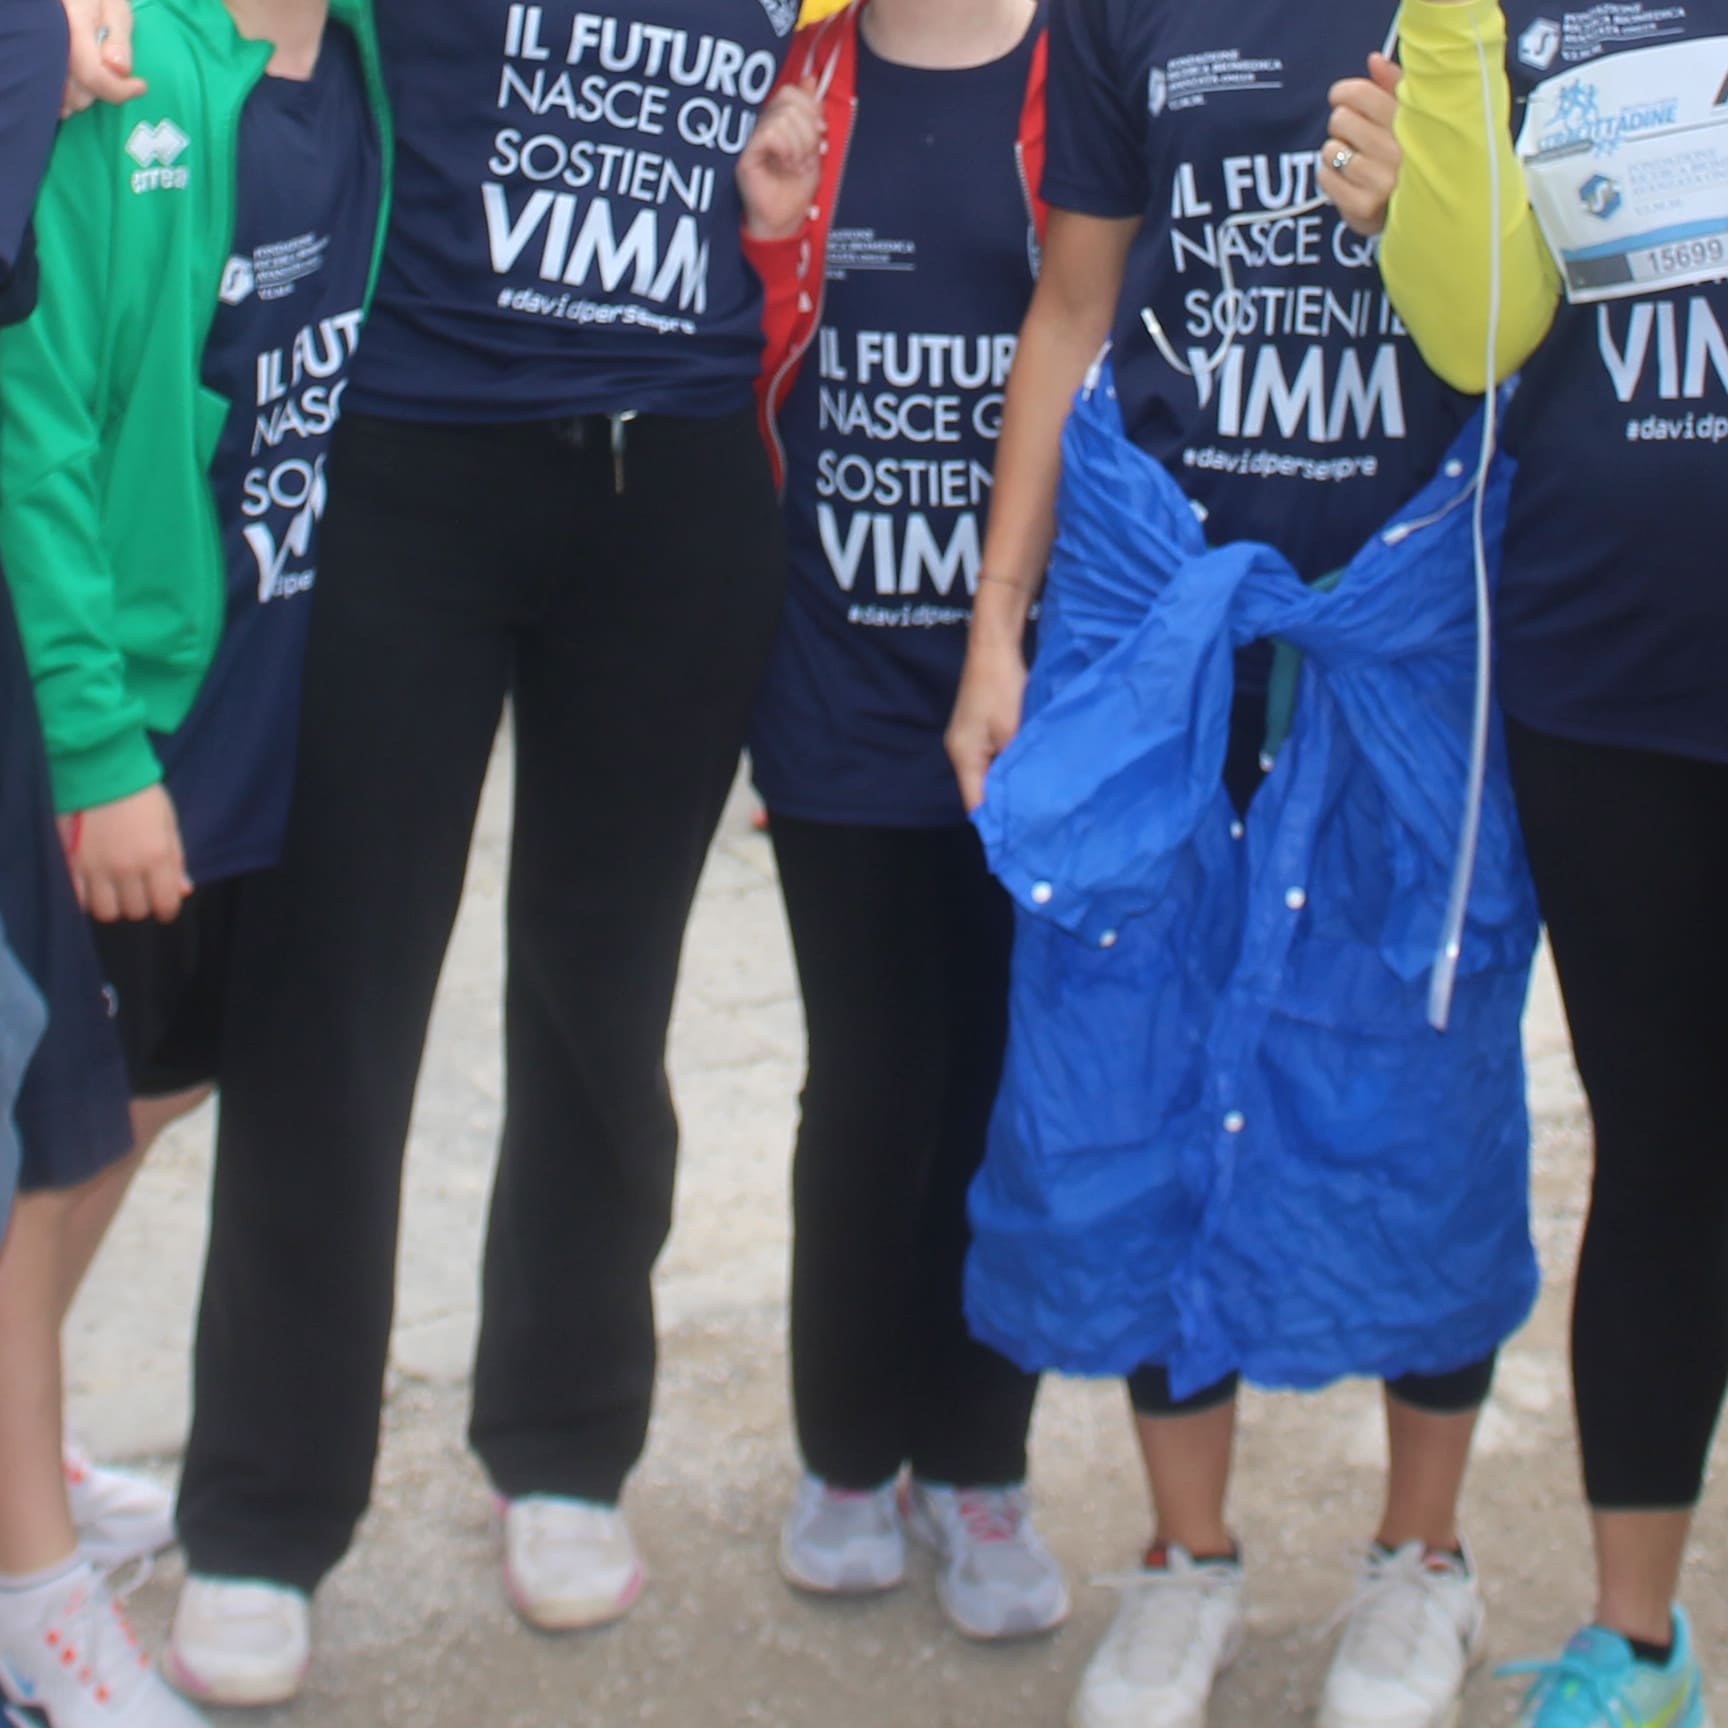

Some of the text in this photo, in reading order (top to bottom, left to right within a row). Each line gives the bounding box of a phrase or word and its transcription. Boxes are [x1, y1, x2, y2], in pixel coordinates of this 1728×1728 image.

[503, 4, 776, 105] IL FUTURO
[497, 63, 670, 135] NASCE
[488, 129, 714, 212] SOSTIENI
[1172, 162, 1212, 219] IL
[481, 181, 709, 314] VIMM
[1170, 216, 1323, 273] NASCE
[1648, 238, 1723, 273] 15699
[1184, 285, 1371, 338] SOSTIENI
[256, 347, 288, 407] IL
[819, 326, 1020, 391] IL FUTUR
[818, 385, 961, 443] NASCE
[815, 449, 994, 509] SOSTIEN
[815, 502, 982, 597] VIM
